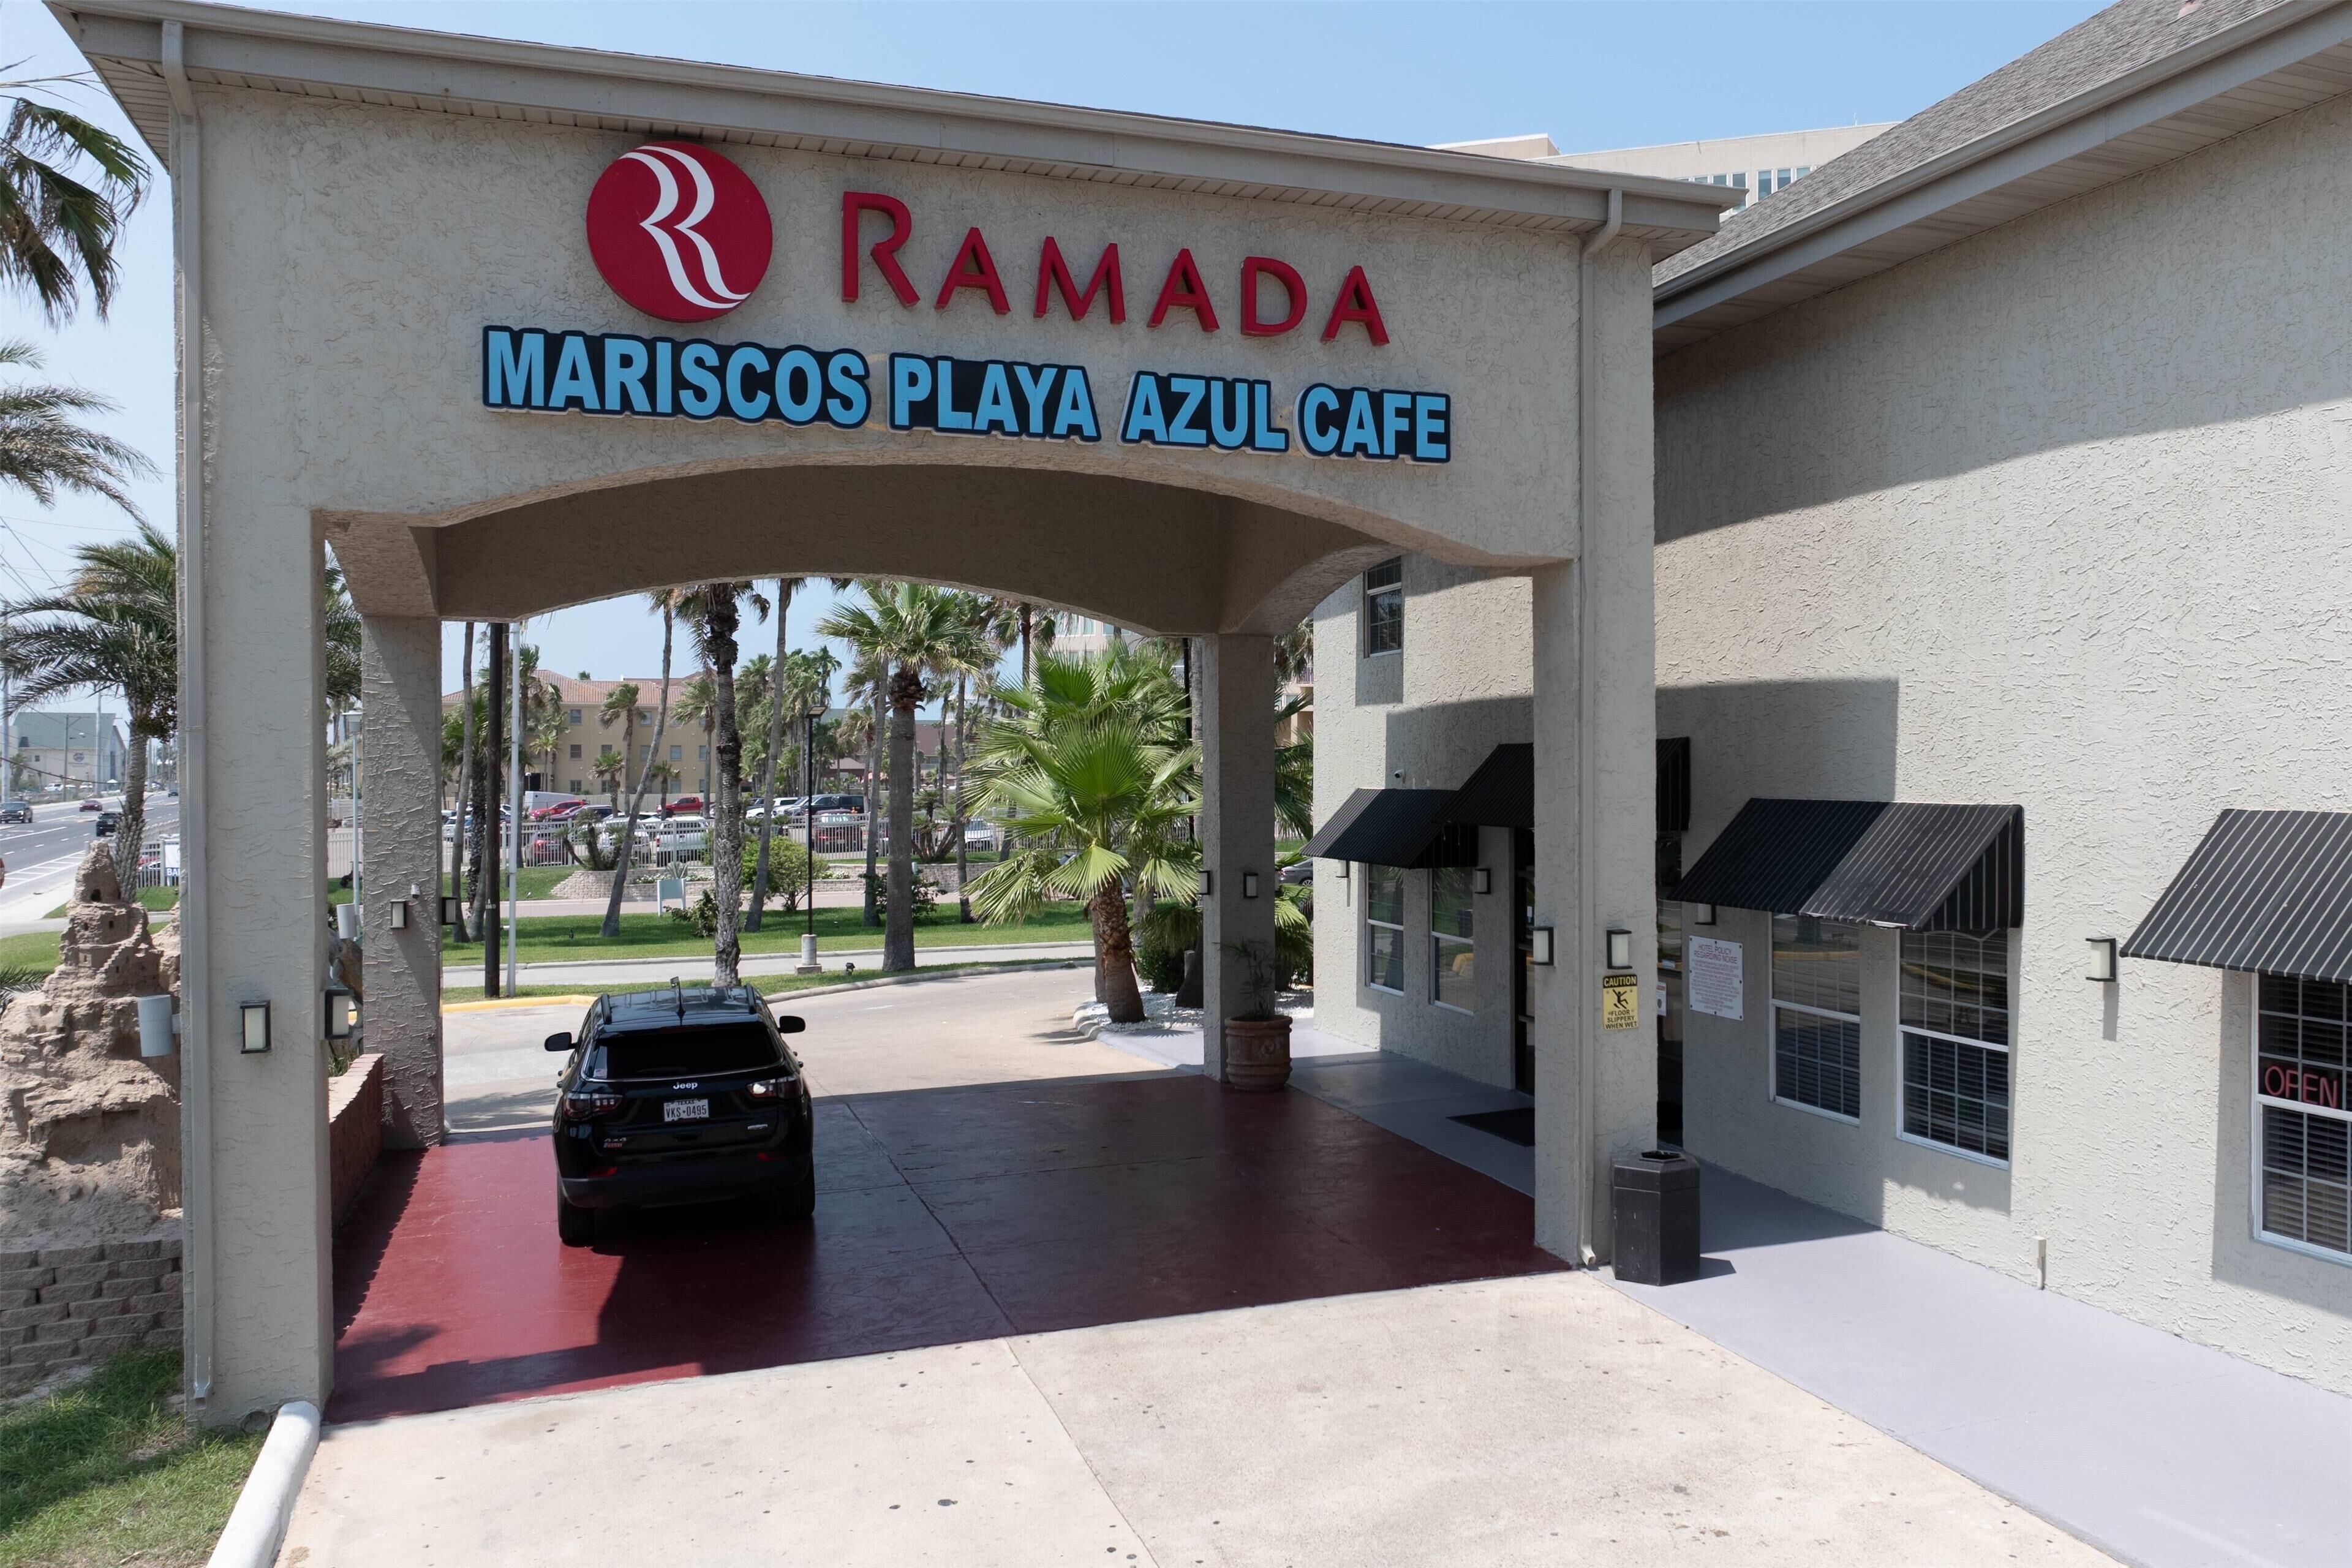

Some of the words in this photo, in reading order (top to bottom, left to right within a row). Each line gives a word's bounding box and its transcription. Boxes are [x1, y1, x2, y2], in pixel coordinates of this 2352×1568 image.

[841, 190, 1390, 346] RAMADA
[487, 330, 867, 426] MARISCOS
[894, 356, 1099, 437] PLAYA
[1125, 374, 1287, 452] AZUL
[1303, 386, 1448, 460] CAFE
[1698, 944, 1714, 952] HOTEL
[1714, 946, 1732, 956] POLICY
[1722, 956, 1737, 965] NOISE
[1604, 976, 1637, 987] CAUTION
[673, 1081, 698, 1090] Jeep
[2264, 1066, 2338, 1108] OPEN
